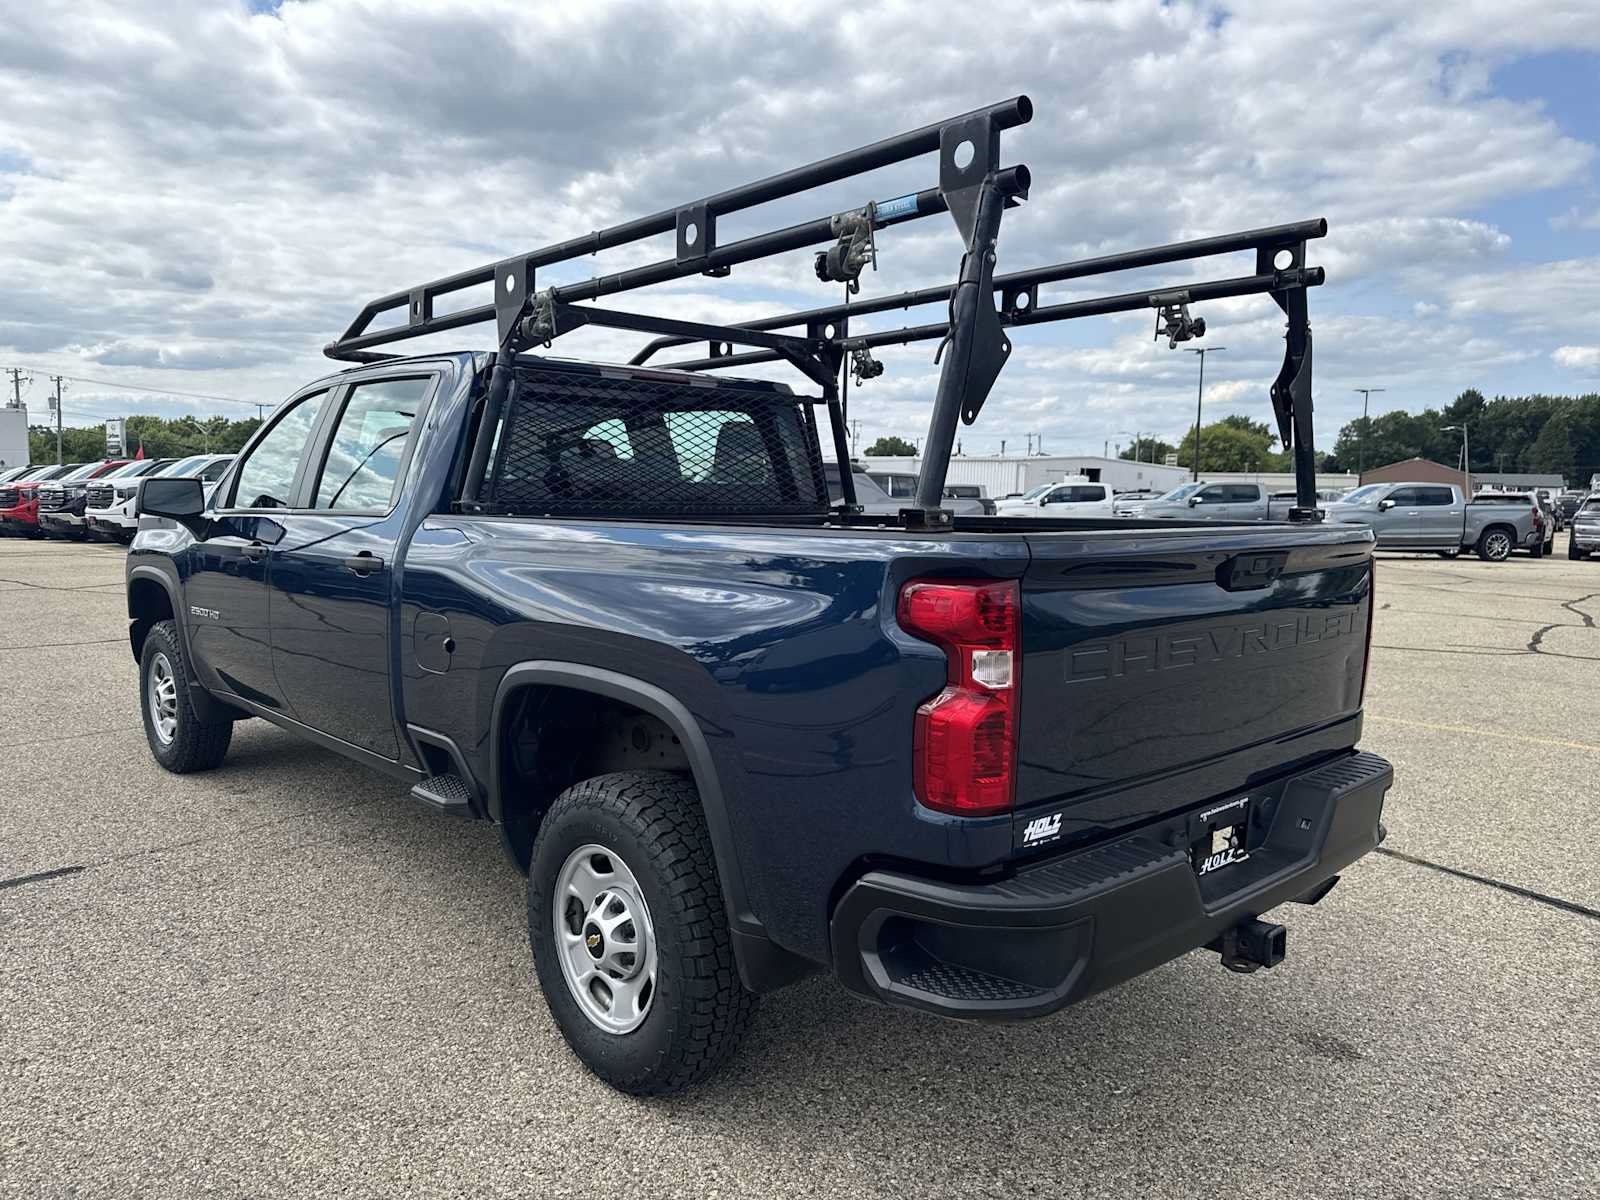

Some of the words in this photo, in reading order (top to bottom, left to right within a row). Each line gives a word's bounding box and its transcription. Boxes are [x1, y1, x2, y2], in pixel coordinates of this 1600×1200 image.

[1064, 607, 1360, 685] CHEVROLET
[1023, 813, 1062, 842] HOLZ
[1199, 848, 1236, 875] HOLZ
